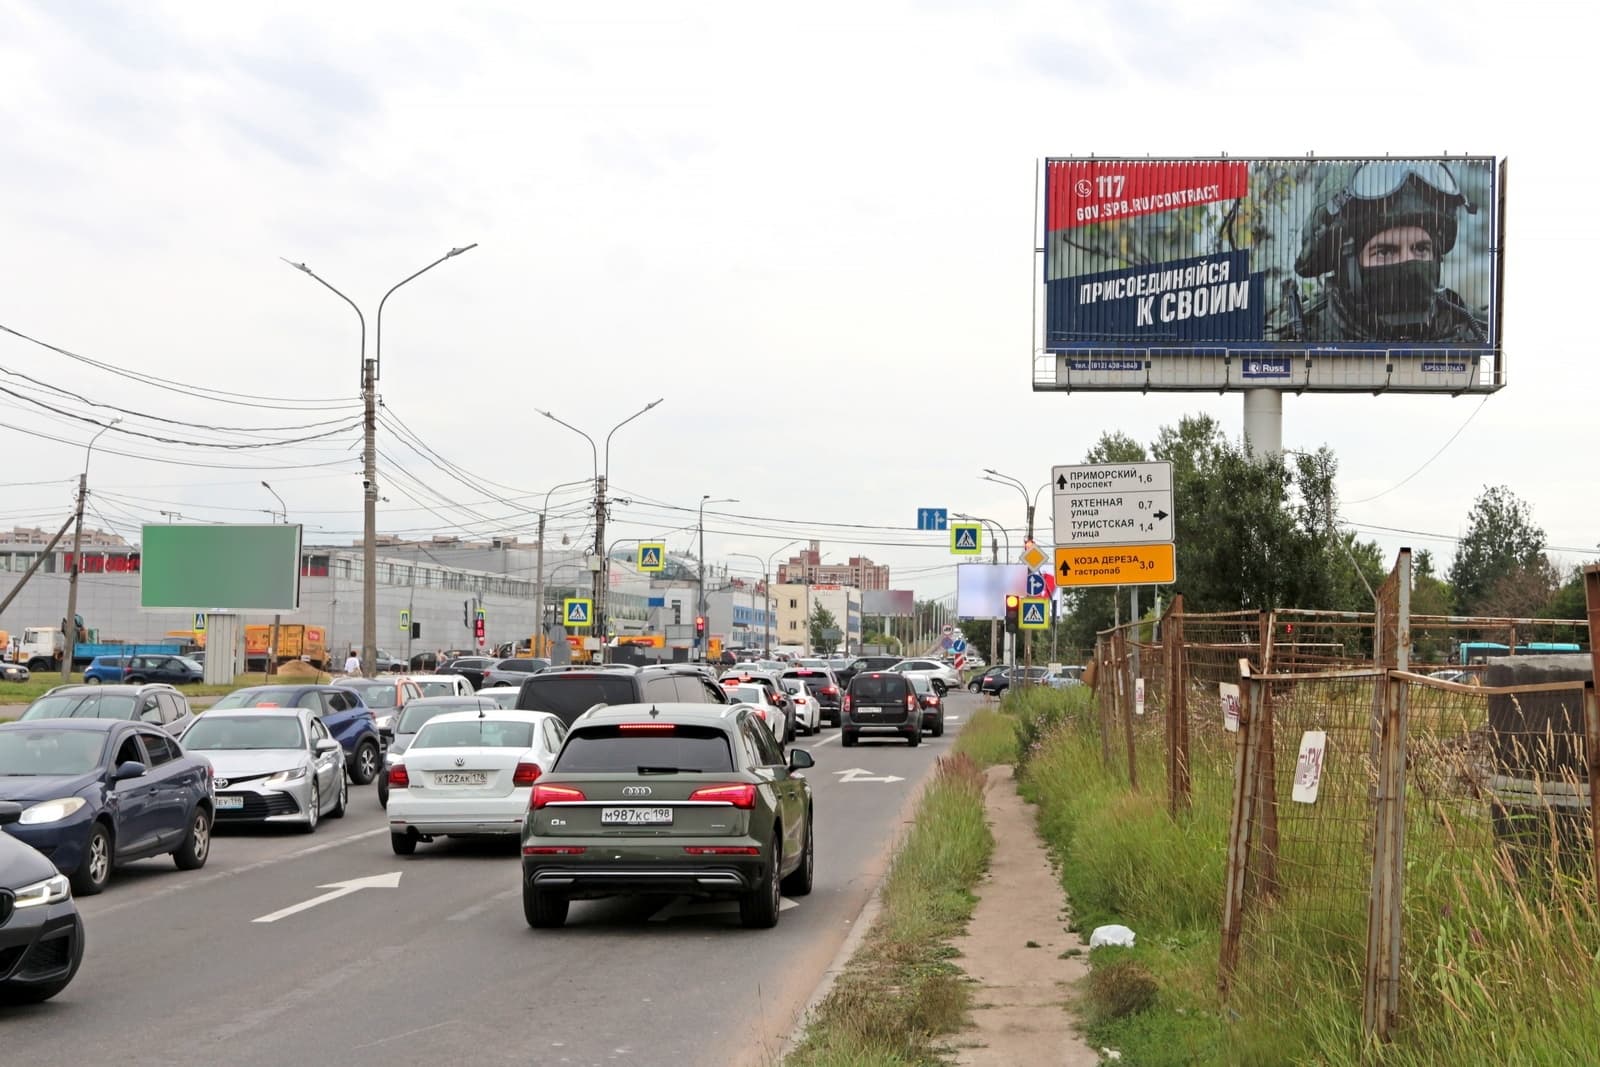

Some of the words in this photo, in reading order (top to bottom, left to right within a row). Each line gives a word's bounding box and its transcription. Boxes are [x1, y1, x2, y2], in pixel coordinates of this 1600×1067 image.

[1096, 176, 1125, 199] 117
[1076, 185, 1220, 221] GOV.SPB.RU/CONTRACT
[1080, 260, 1230, 304] ПРИСОЕДИНЯЙСЯ
[1137, 297, 1154, 326] К
[1160, 281, 1249, 323] СВОИМ
[1262, 364, 1284, 373] Russ
[1070, 468, 1137, 480] ПРИМОРСКИЙ
[1138, 474, 1153, 484] 1,6
[1070, 480, 1112, 490] проспект
[1070, 498, 1123, 508] ЯХТЕННАЯ
[1138, 501, 1153, 510] 0,7
[1071, 510, 1099, 518] улица
[1072, 519, 1134, 529] ТУРИСТСКАЯ
[1139, 523, 1153, 533] 1,4
[1072, 531, 1099, 540] улица
[1074, 557, 1099, 565] КОЗА
[1102, 556, 1139, 565] ДЕРЕЗА
[1140, 560, 1154, 570] 3,0
[1074, 567, 1120, 576] гастропаб
[604, 809, 650, 821] М987КС
[653, 809, 670, 818] 198
